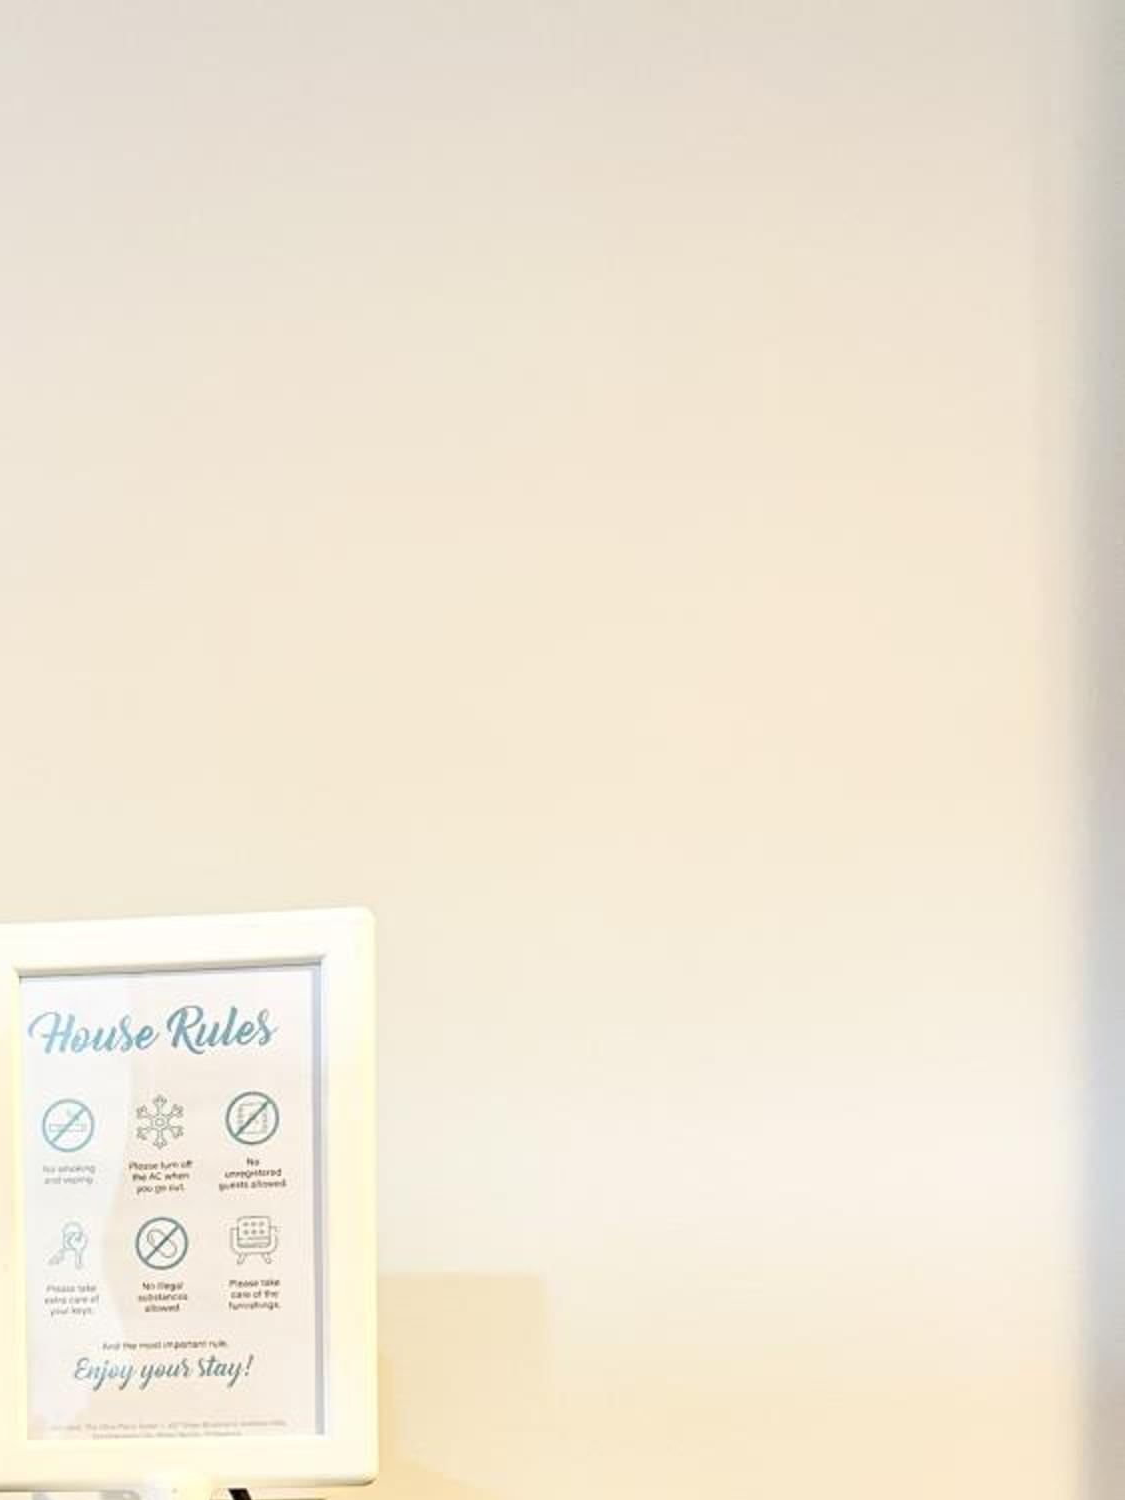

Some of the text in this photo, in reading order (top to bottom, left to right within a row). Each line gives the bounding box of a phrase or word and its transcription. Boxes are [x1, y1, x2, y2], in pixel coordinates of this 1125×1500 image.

[27, 1003, 279, 1055] House Rules
[128, 1162, 158, 1171] Please
[160, 1161, 179, 1169] turn
[247, 1157, 260, 1166] No
[132, 1171, 189, 1181] the AC when
[136, 1185, 153, 1194] you
[218, 1181, 248, 1191] guests
[142, 1281, 183, 1291] No illegal
[228, 1278, 281, 1288] Please take
[138, 1293, 188, 1302] substances
[230, 1290, 251, 1299] care
[264, 1289, 279, 1297] the
[74, 1354, 254, 1391] Enjoy your stay!
